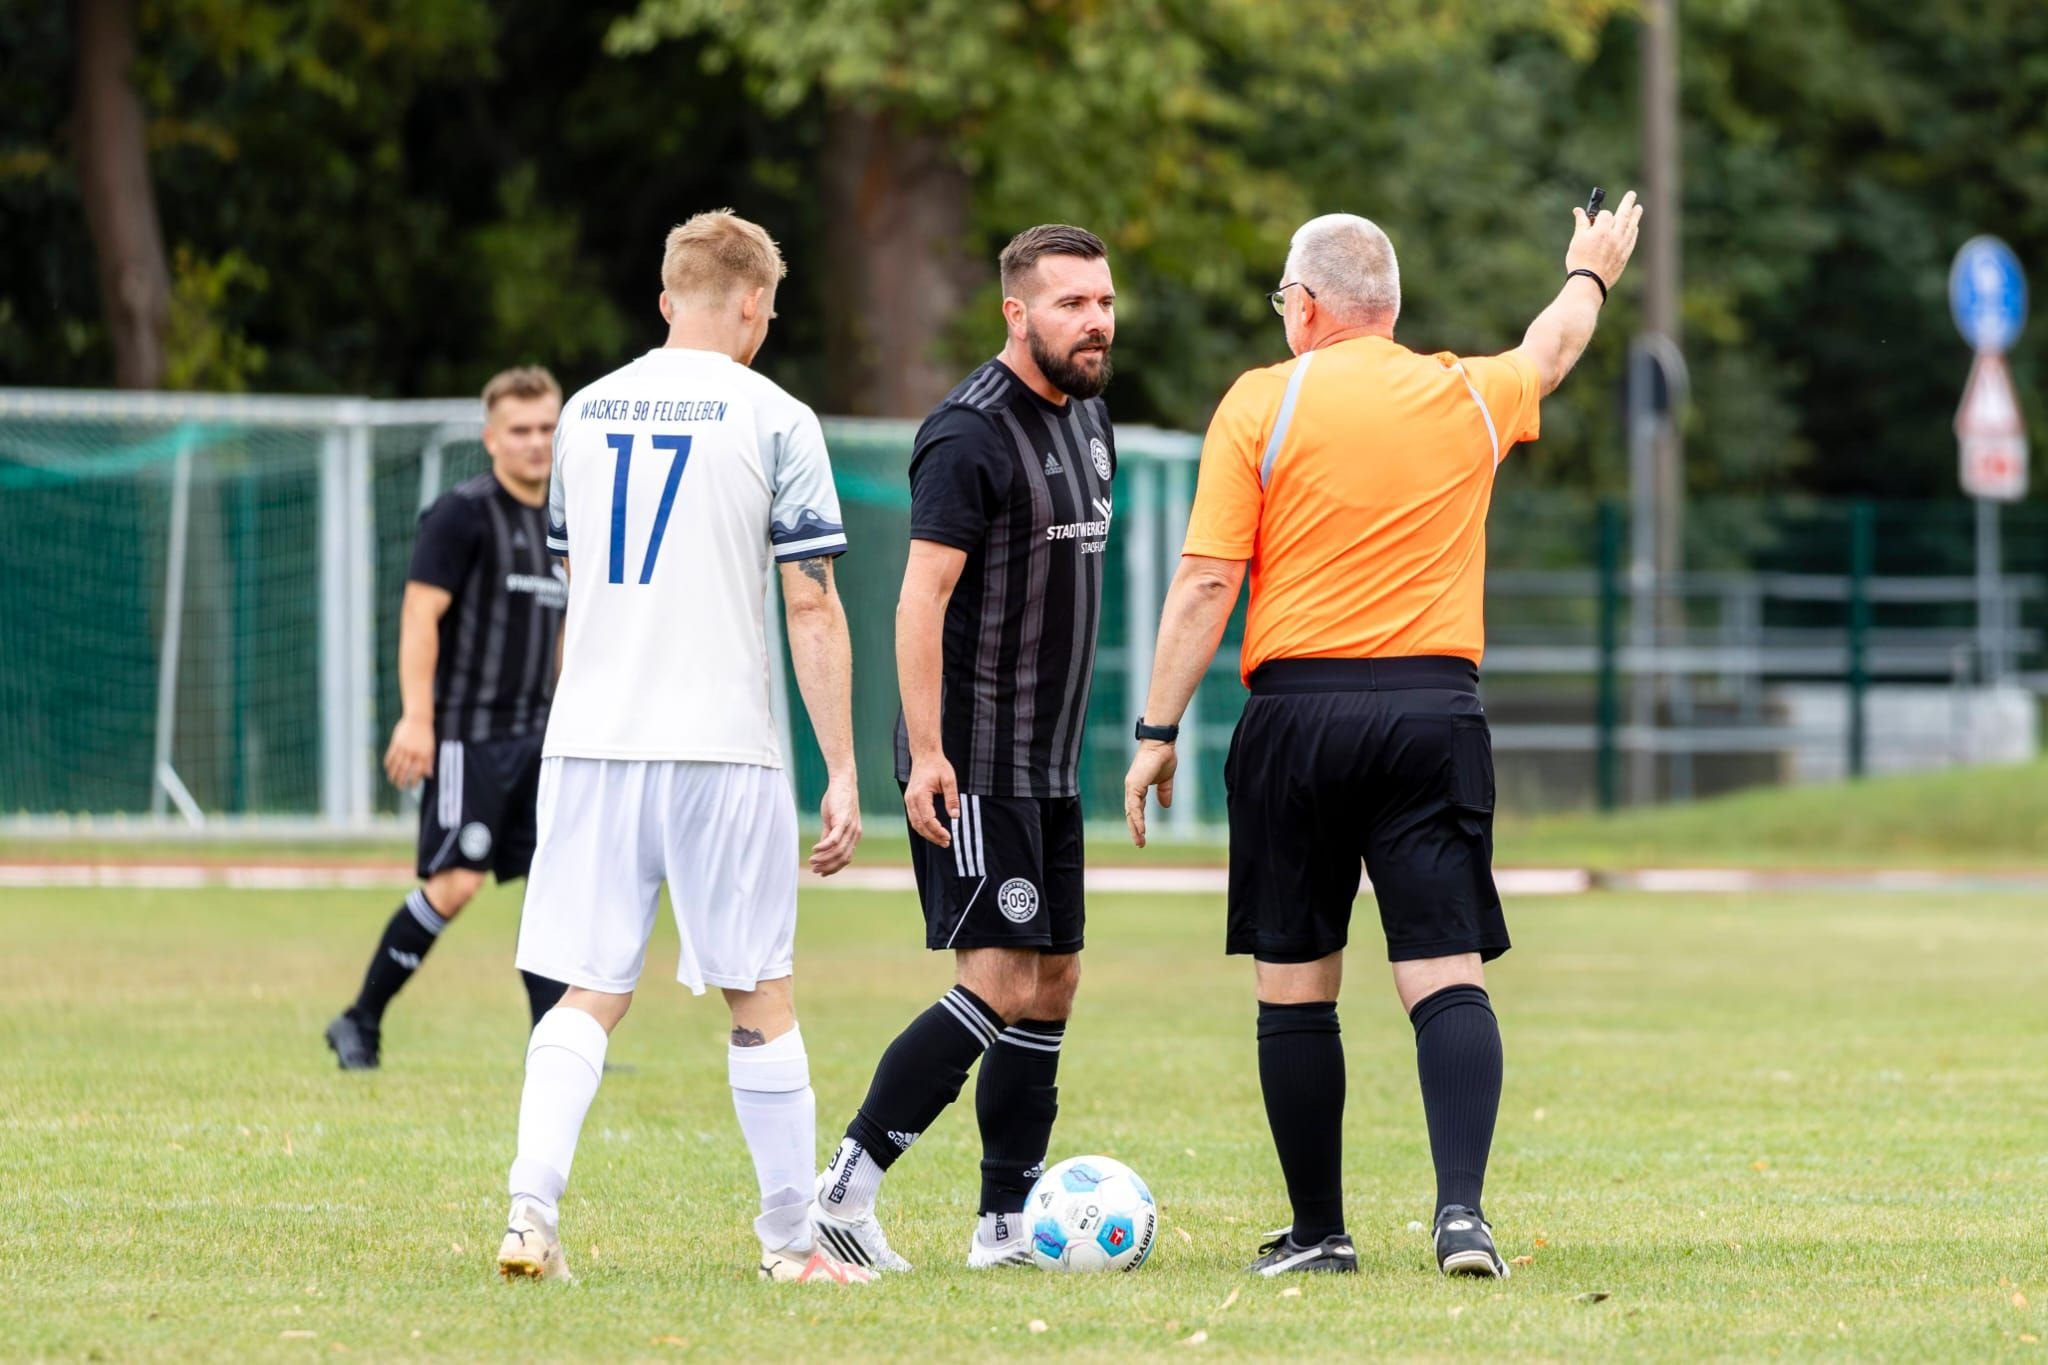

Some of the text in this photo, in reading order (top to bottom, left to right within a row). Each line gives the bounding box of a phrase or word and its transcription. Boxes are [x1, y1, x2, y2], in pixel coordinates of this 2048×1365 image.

[580, 399, 728, 422] WACKER 90 FELGELEBEN
[606, 433, 693, 584] 17
[1046, 521, 1106, 540] STADTWERKE
[1009, 892, 1027, 908] 09
[829, 1185, 846, 1204] FS
